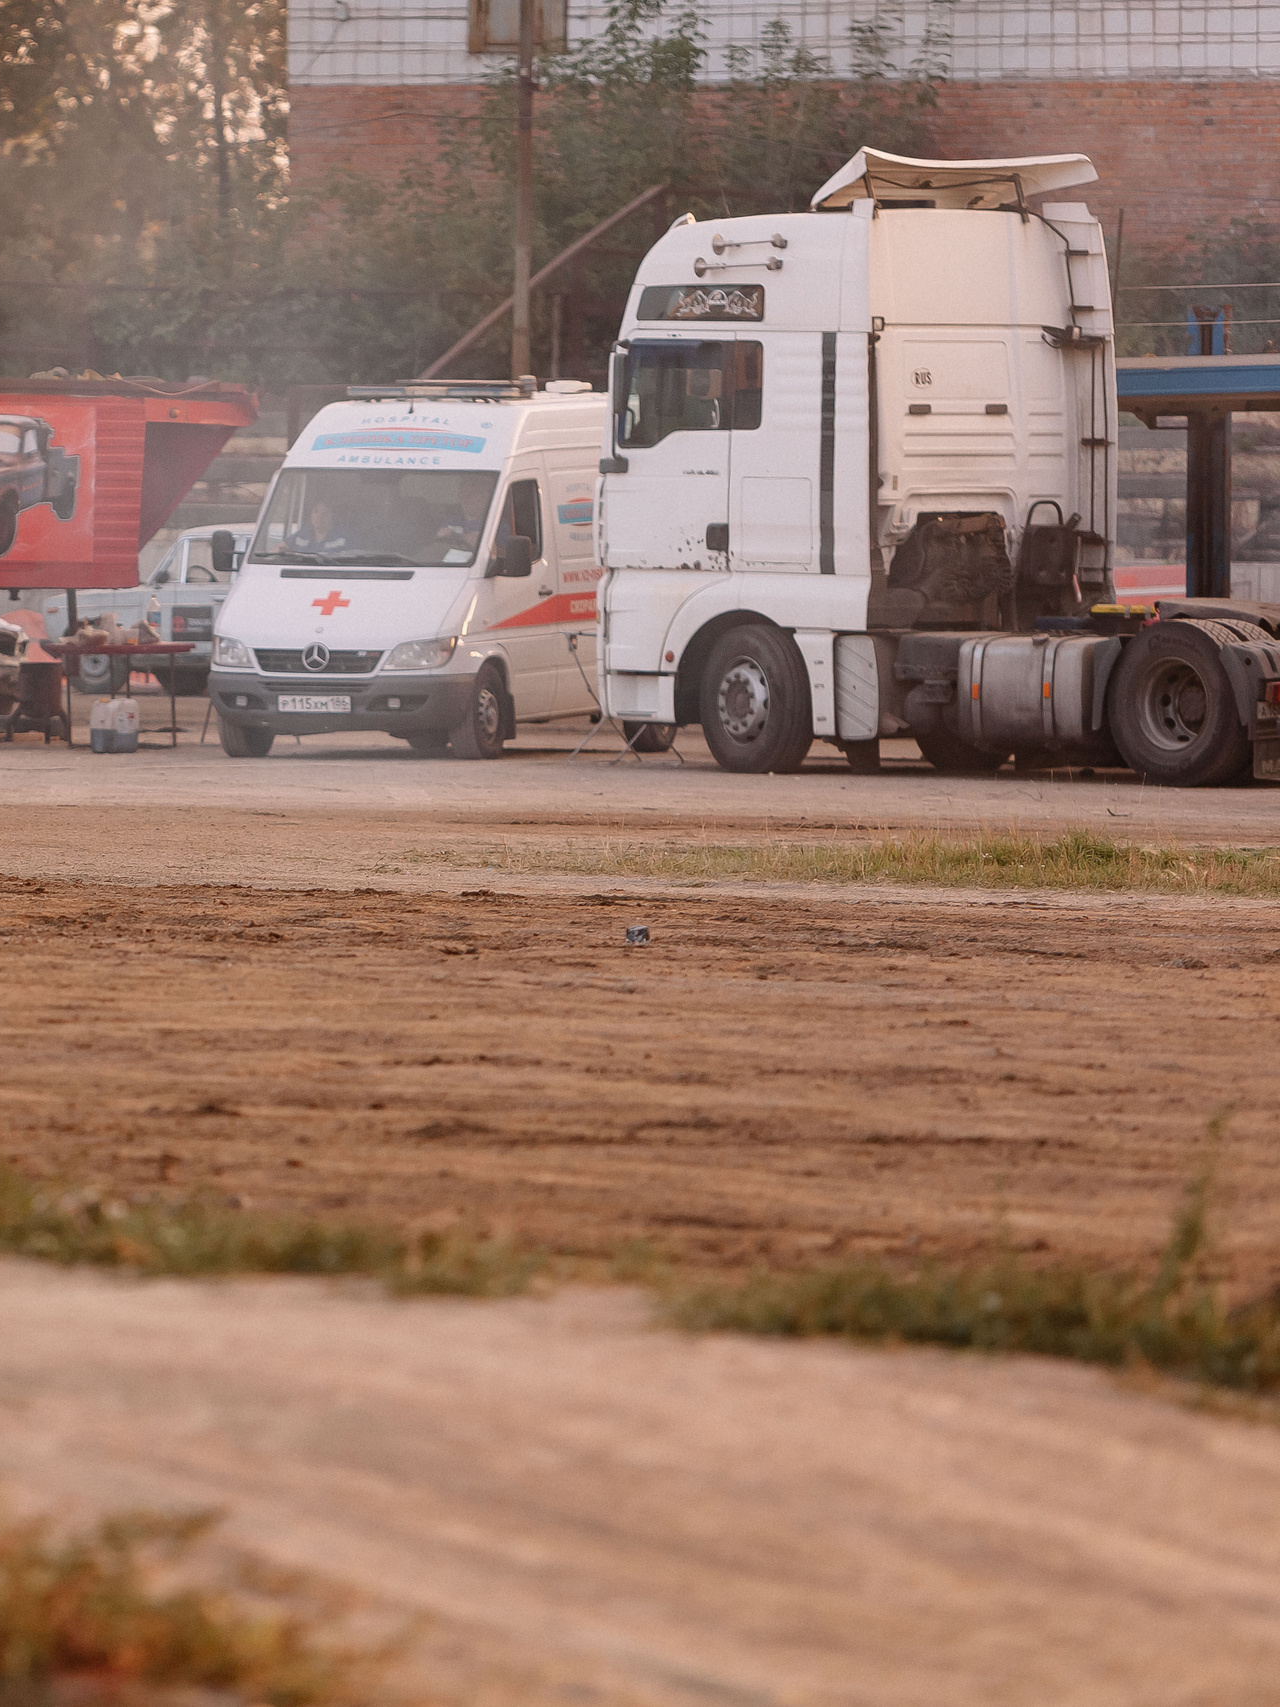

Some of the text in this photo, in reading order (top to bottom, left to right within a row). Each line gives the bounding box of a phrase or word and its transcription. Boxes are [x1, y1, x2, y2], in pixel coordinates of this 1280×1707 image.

[914, 371, 932, 386] RUS
[361, 416, 450, 426] HOSPITAL
[337, 455, 441, 465] AMBULANCE
